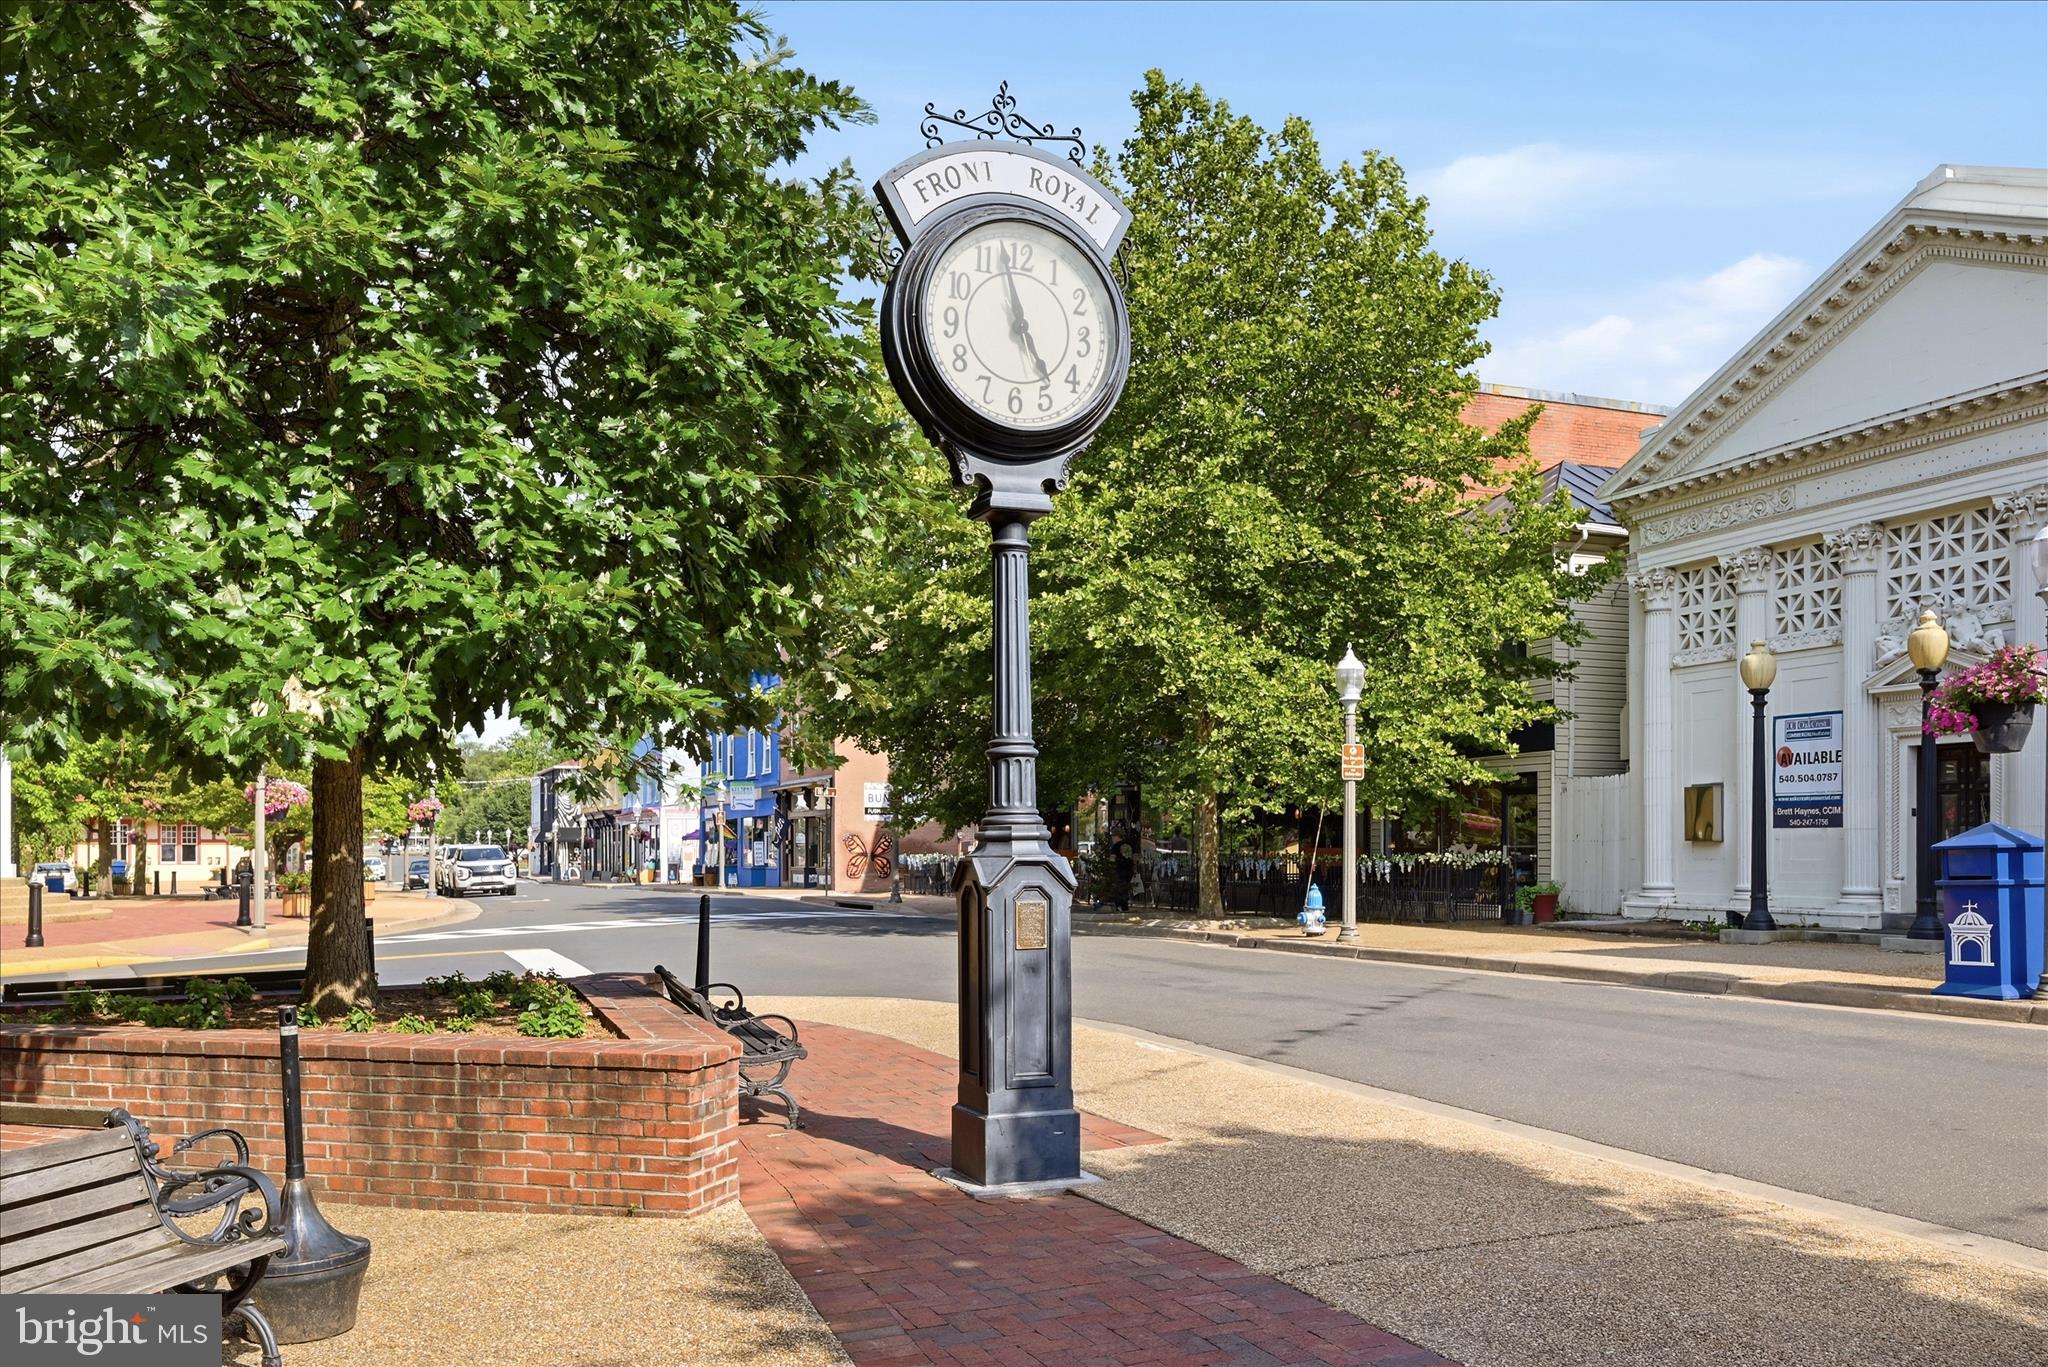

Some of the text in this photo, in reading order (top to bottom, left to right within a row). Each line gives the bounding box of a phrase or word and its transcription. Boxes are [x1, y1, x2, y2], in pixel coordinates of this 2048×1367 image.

[1029, 167, 1100, 224] ROYAL
[974, 244, 993, 274] 11
[1009, 242, 1034, 272] 12
[947, 270, 971, 301] 10
[1049, 259, 1059, 286] 1
[1073, 287, 1088, 316] 2
[943, 306, 959, 338] 9
[1076, 326, 1091, 358] 3
[952, 343, 967, 372] 8
[976, 375, 994, 405] 7
[1064, 363, 1080, 394] 4
[1008, 386, 1023, 415] 6
[1037, 385, 1053, 412] 5
[1780, 749, 1842, 766] AVAILABLE
[1778, 773, 1838, 784] 540.504.0787
[1777, 807, 1793, 816] Brett
[1822, 806, 1841, 815] CCIM
